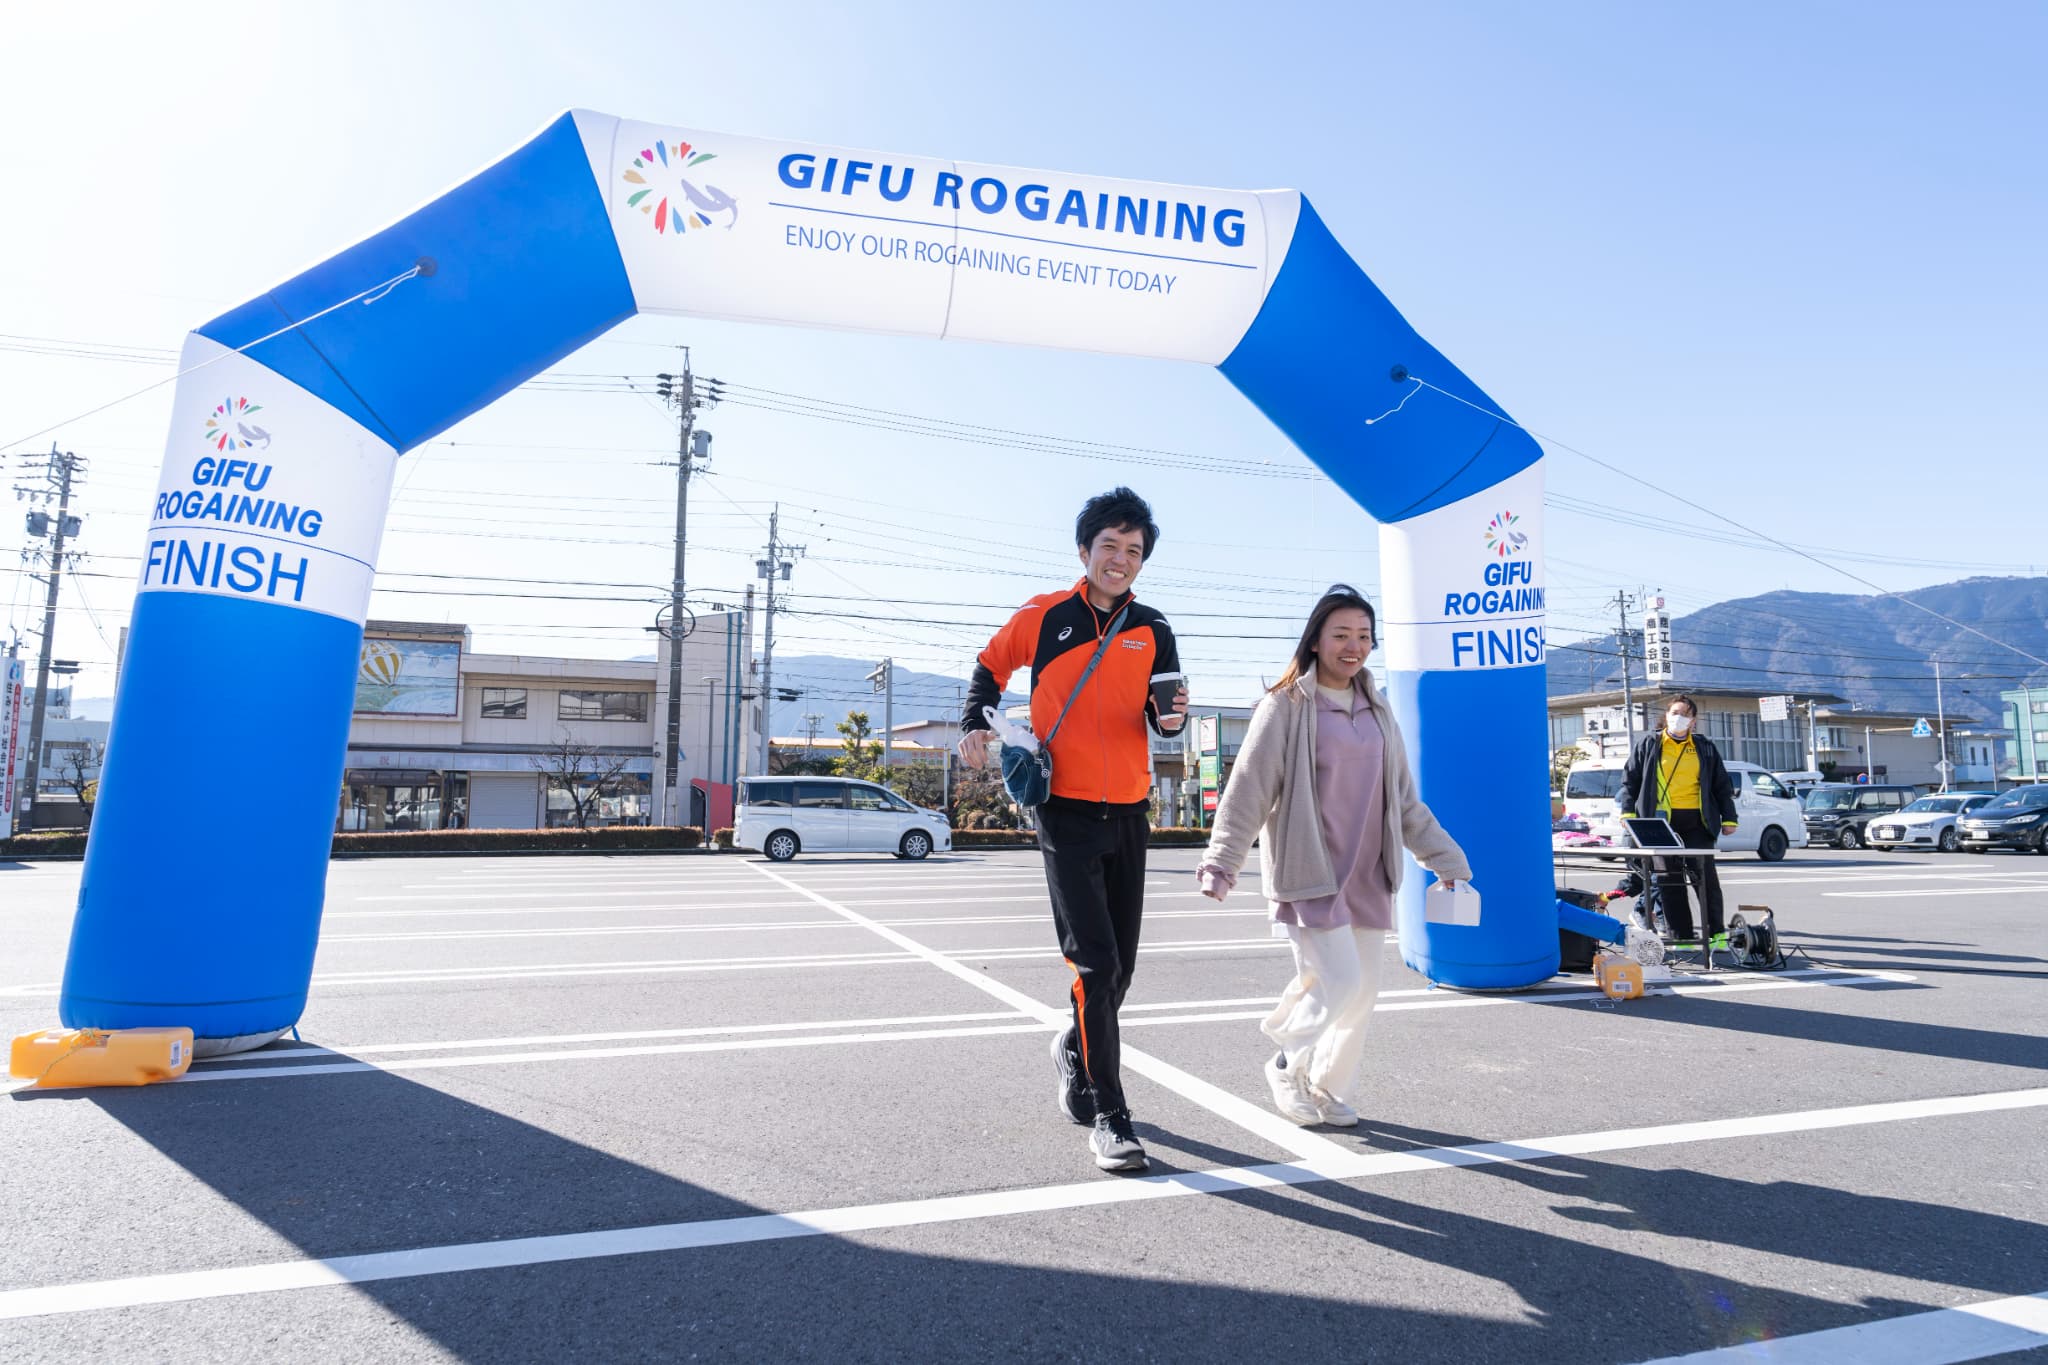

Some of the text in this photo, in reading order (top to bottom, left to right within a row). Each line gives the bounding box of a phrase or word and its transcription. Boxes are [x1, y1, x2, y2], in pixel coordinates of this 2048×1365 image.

[778, 153, 1246, 248] GIFU ROGAINING
[786, 224, 1177, 294] ENJOY OUR ROGAINING EVENT TODAY
[192, 456, 273, 492] GIFU
[154, 490, 323, 538] ROGAINING
[144, 539, 309, 602] FINISH
[1484, 561, 1532, 587] GIFU
[1444, 586, 1546, 616] ROGAININ
[1647, 617, 1660, 674] 商工会館
[1660, 616, 1672, 674] 商工会館
